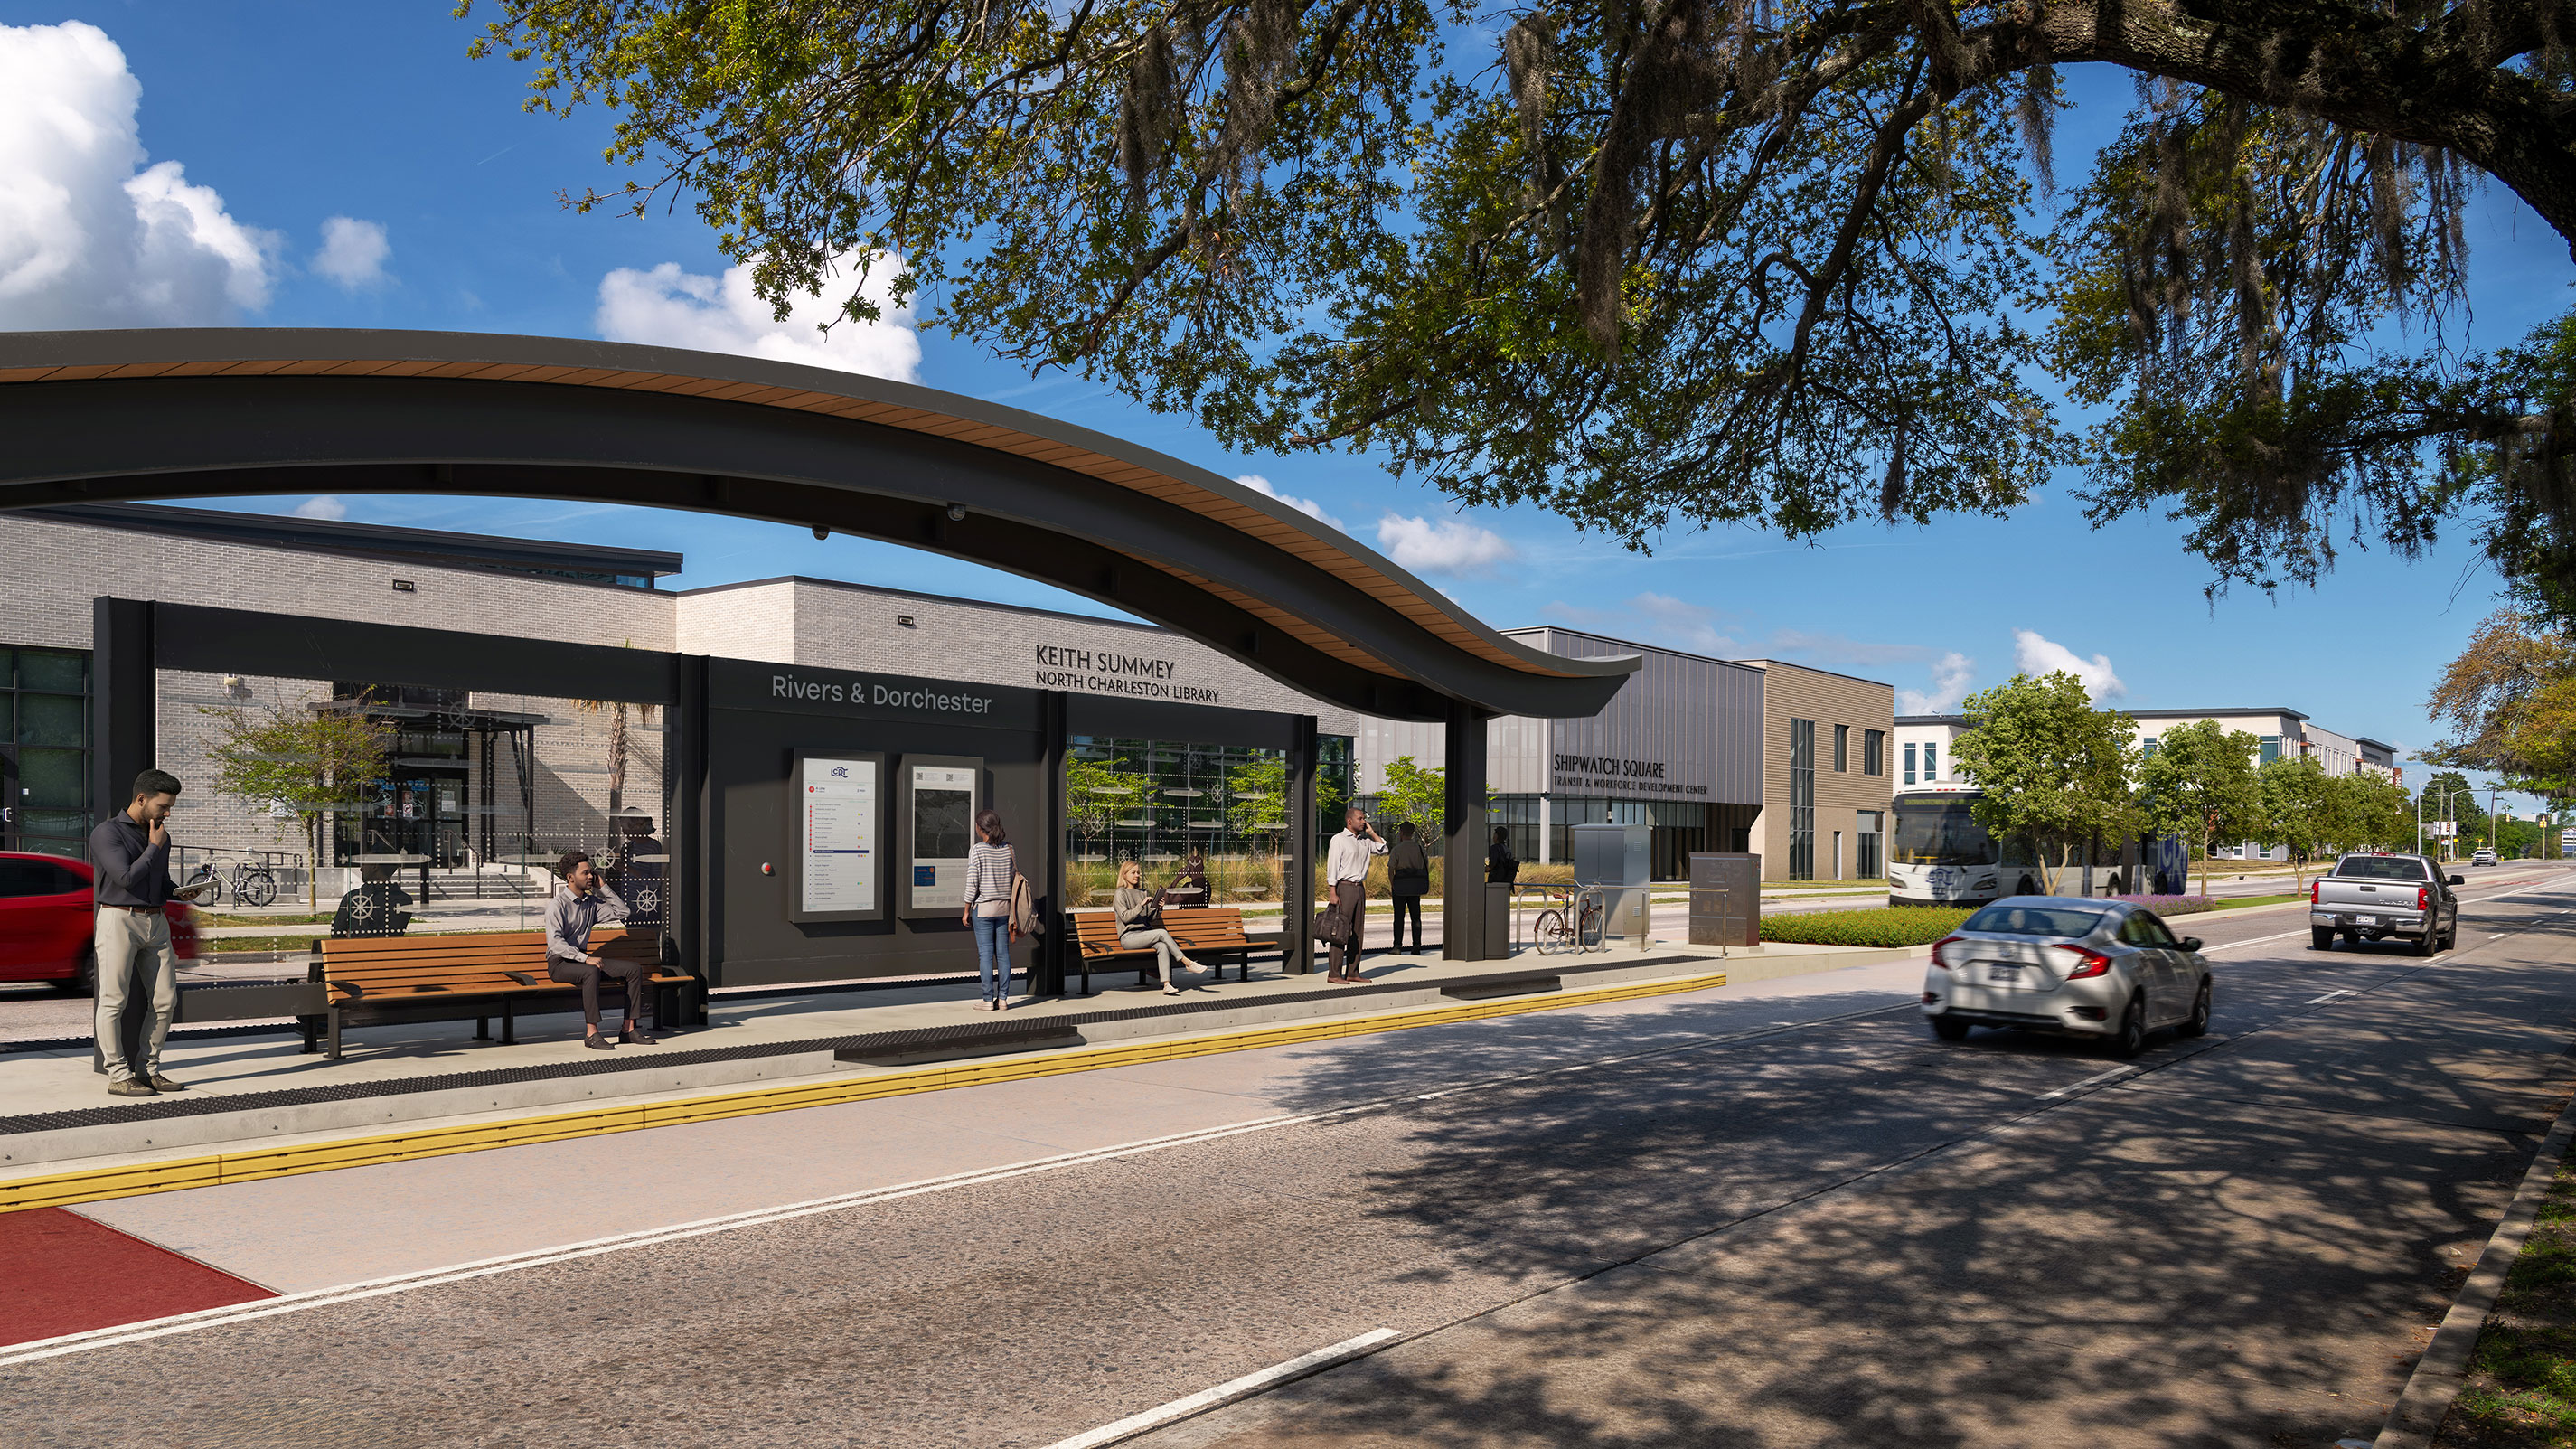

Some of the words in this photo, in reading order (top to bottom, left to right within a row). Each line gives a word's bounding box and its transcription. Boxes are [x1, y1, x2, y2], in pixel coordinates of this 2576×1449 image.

[1036, 645, 1091, 670] KEITH
[1097, 653, 1175, 680] SUMMEY
[772, 673, 843, 702] Rivers
[851, 682, 865, 704] &
[873, 684, 992, 714] Dorchester
[1036, 671, 1084, 689] NORTH
[1088, 676, 1169, 698] CHARLESTON
[1173, 686, 1220, 703] LIBRARY
[1554, 754, 1620, 776] SHIPWATCH
[1623, 760, 1665, 778] SQUARE
[1554, 776, 1582, 787] TRANSIT
[1585, 779, 1591, 788] &
[1594, 779, 1636, 791] WORKFORCE
[1639, 783, 1683, 794] DEVELOPMENT
[1686, 785, 1708, 795] CENTER
